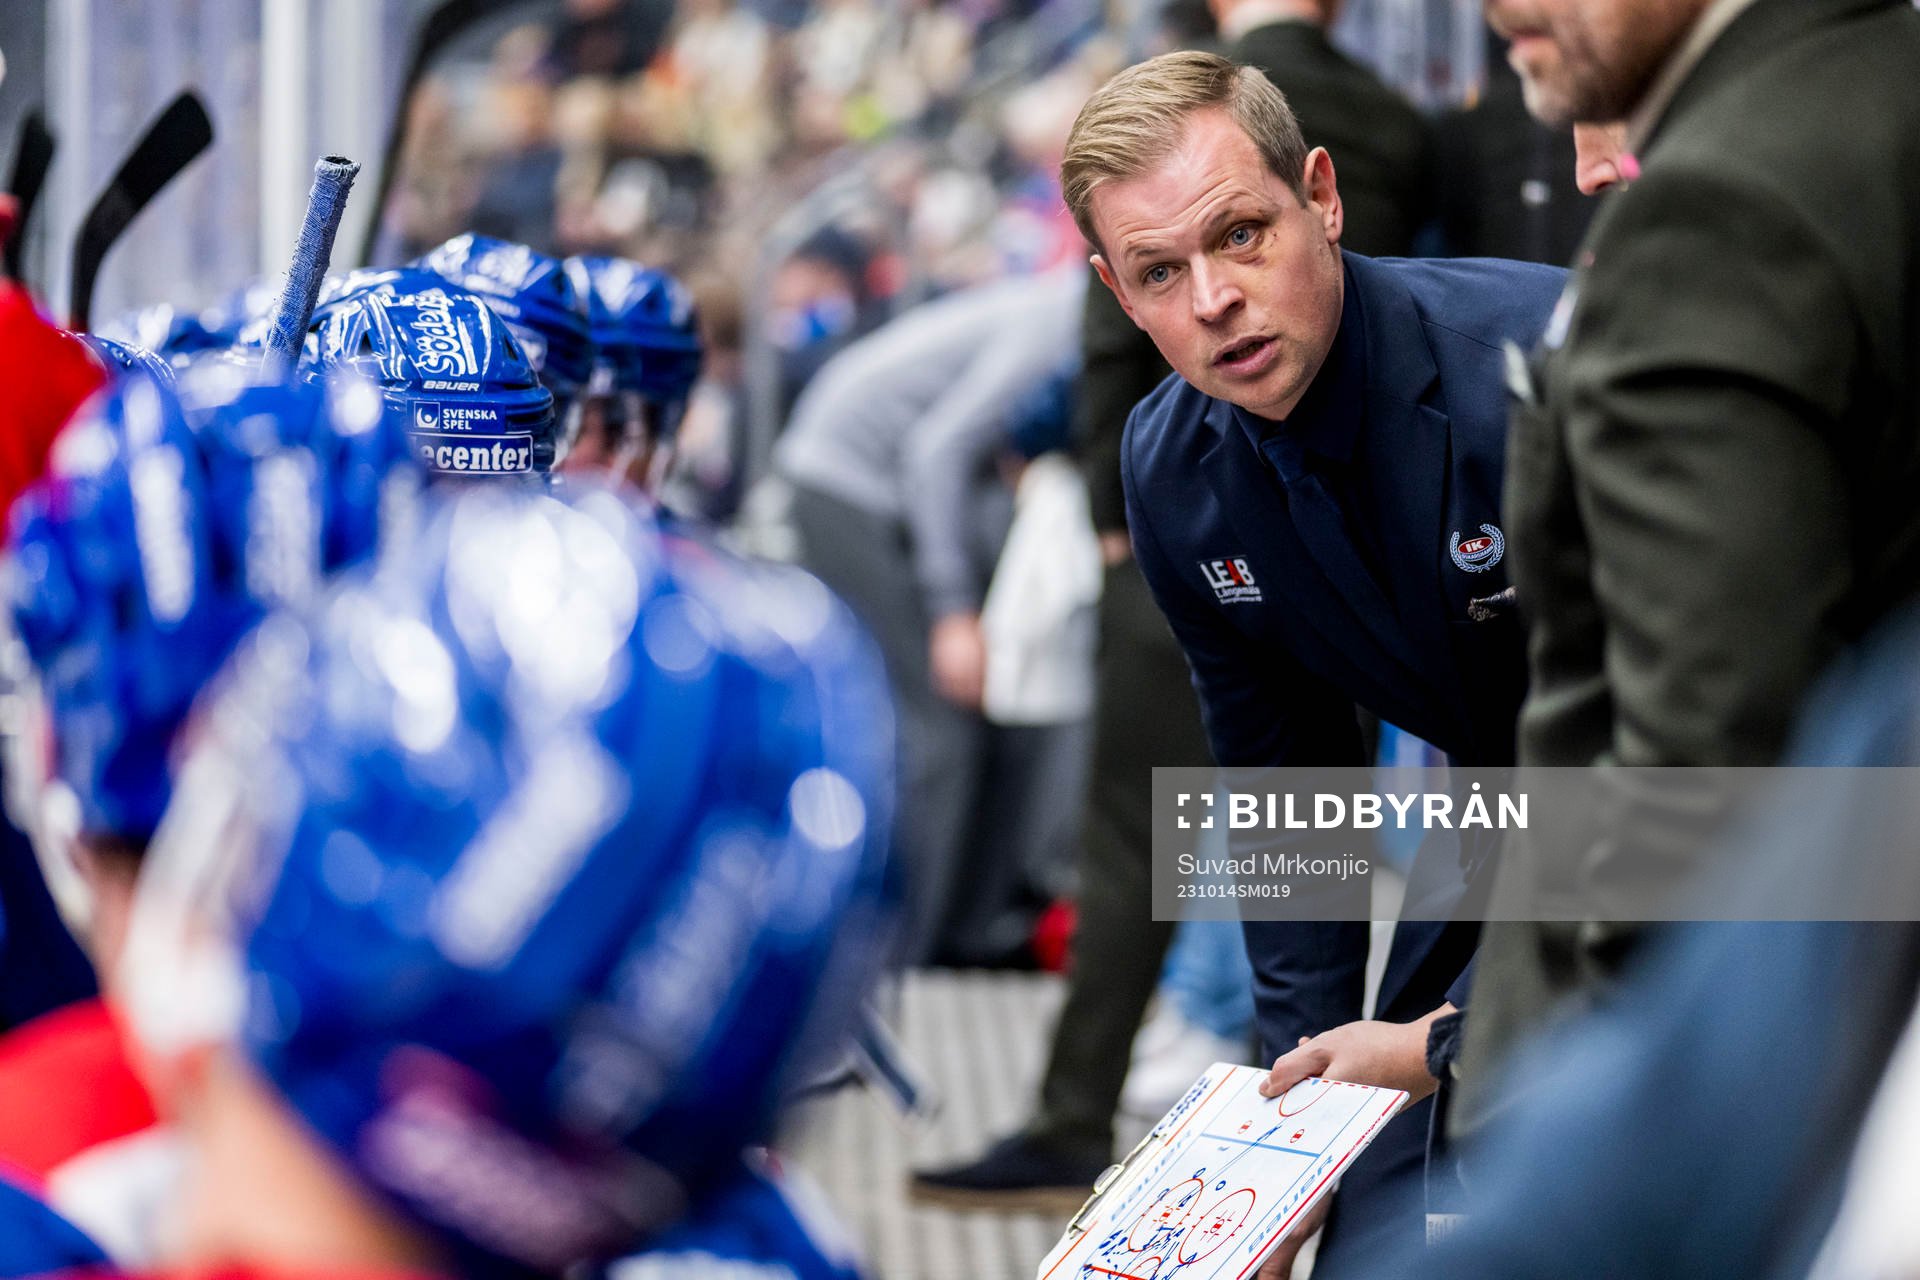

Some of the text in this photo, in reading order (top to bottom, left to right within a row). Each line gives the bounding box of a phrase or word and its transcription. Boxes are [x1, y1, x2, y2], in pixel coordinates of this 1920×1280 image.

[423, 380, 480, 392] BAUER
[442, 408, 498, 420] SVENSKA
[442, 419, 472, 430] SPEL
[420, 441, 530, 471] ecenter
[1465, 540, 1485, 553] IK
[1199, 558, 1255, 589] LEAB
[1248, 1154, 1334, 1254] BAUER
